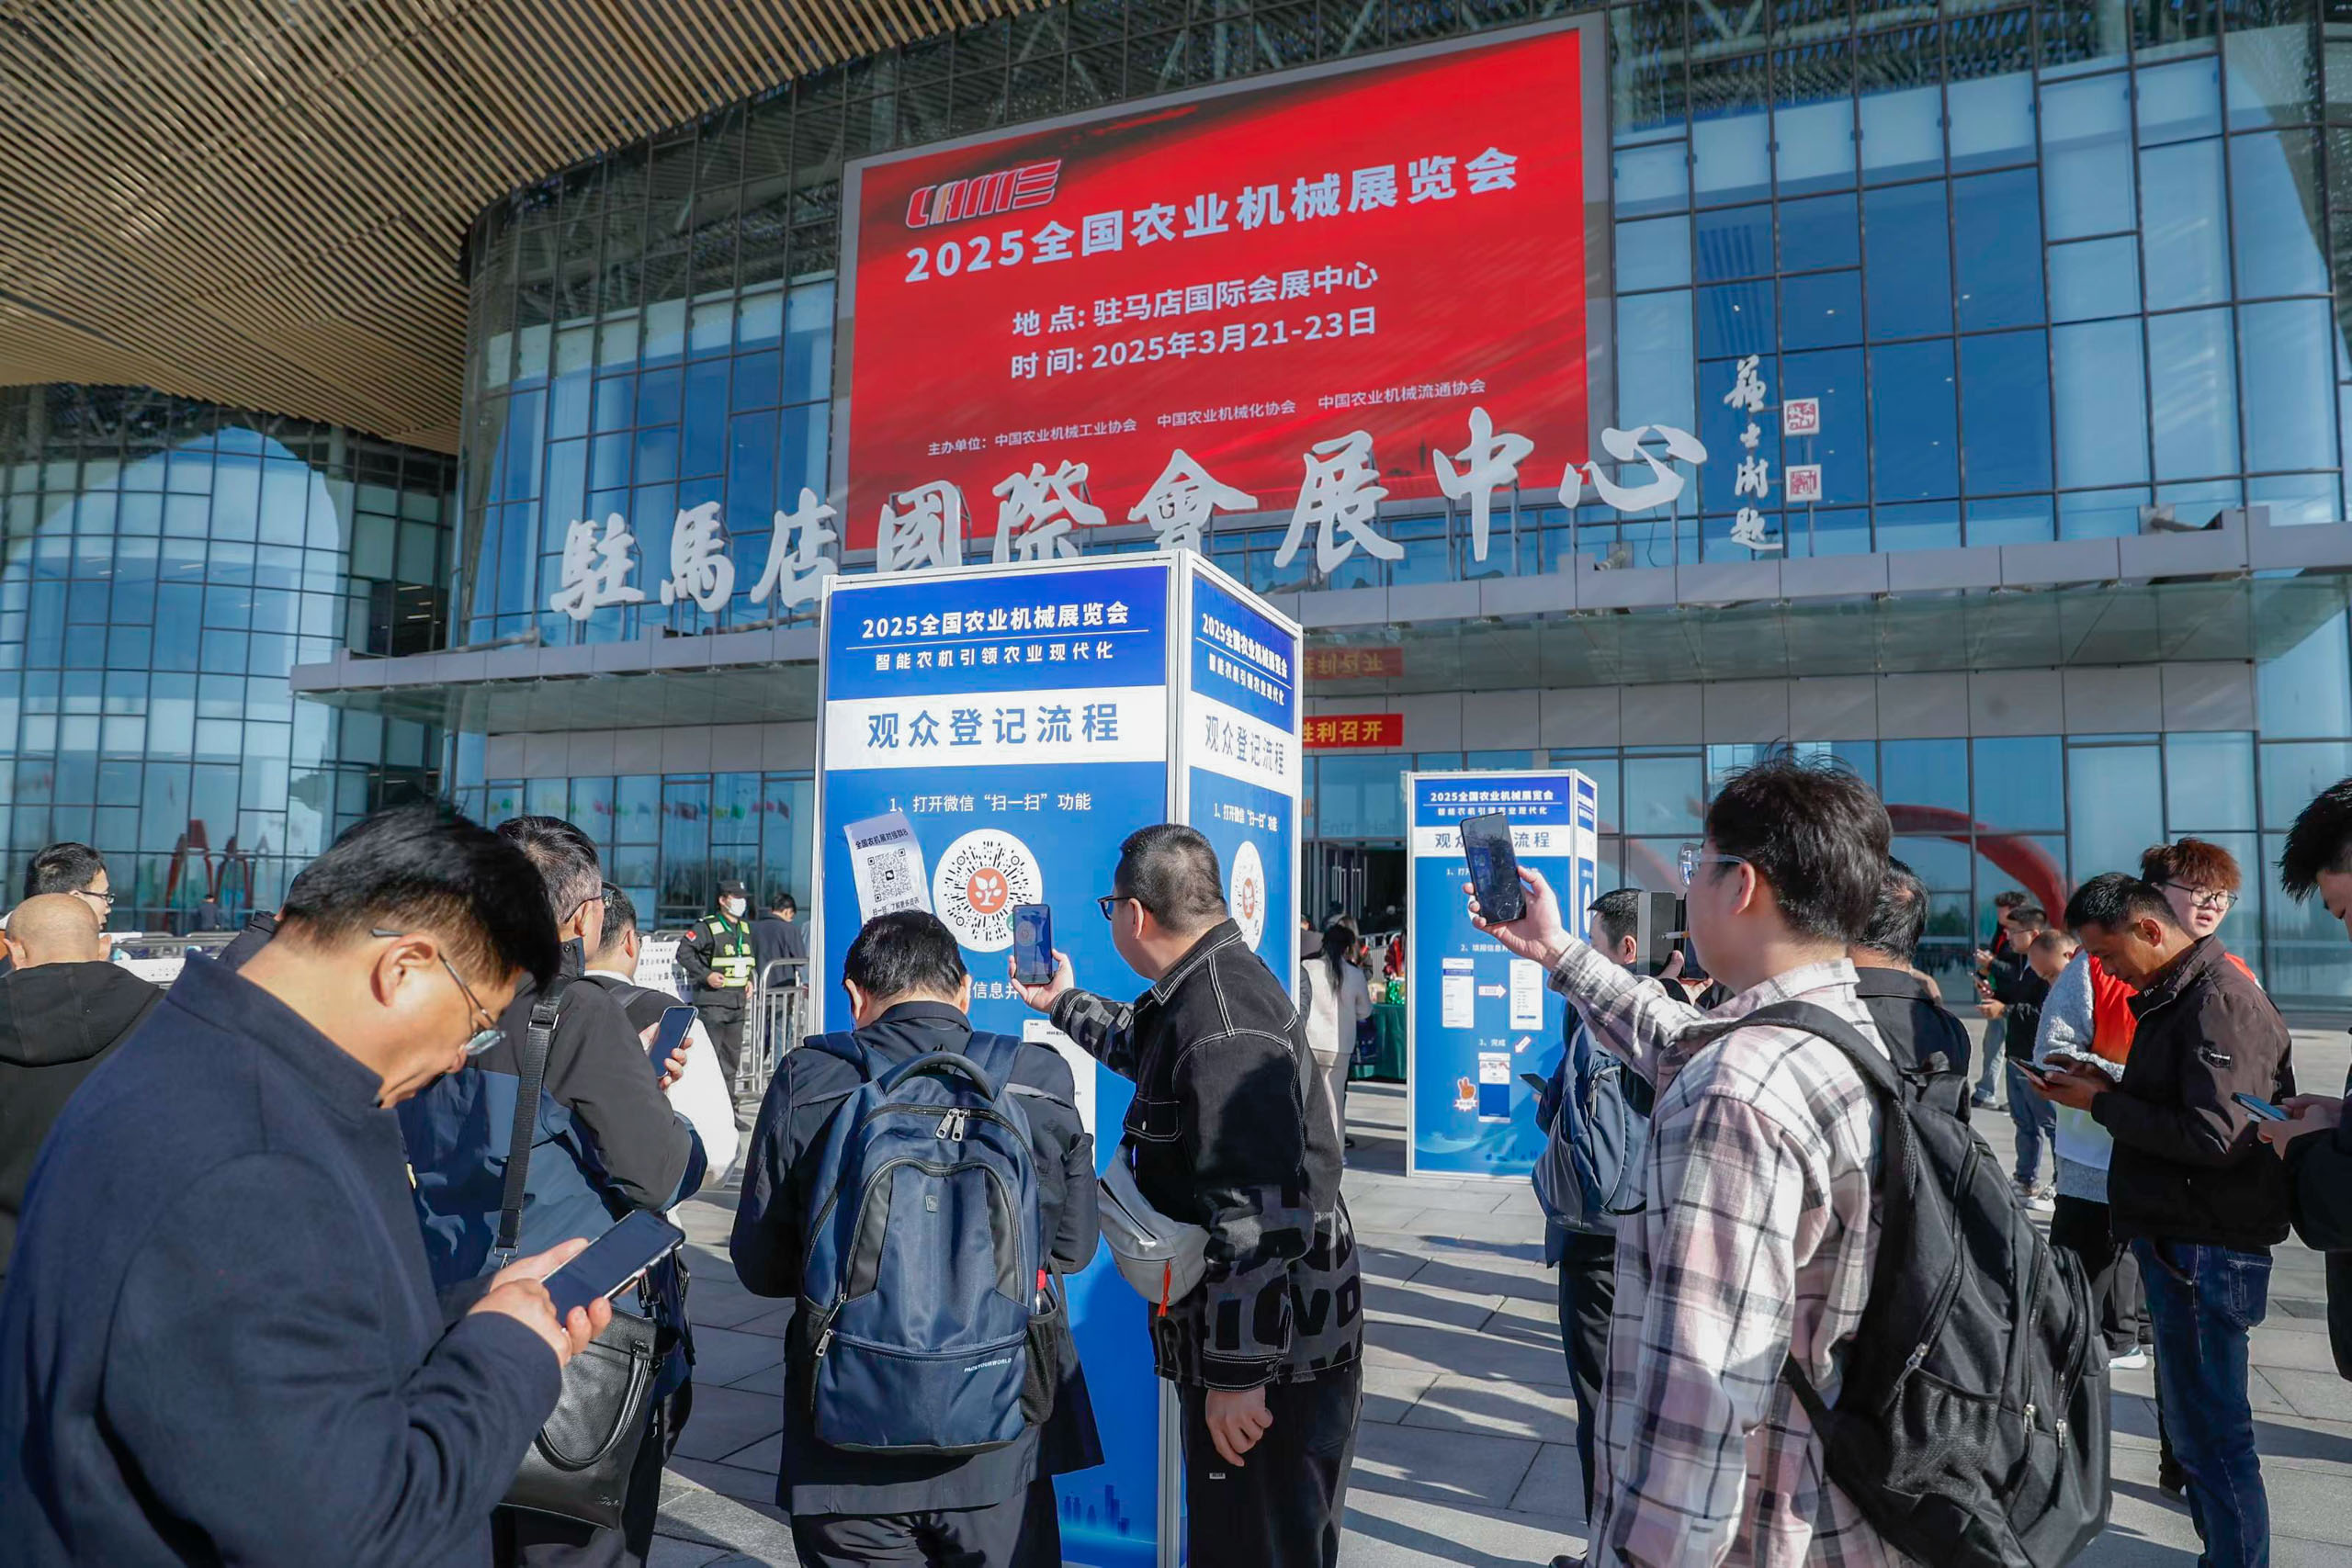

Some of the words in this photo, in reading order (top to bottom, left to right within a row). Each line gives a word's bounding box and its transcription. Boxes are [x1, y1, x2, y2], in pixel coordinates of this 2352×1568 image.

[904, 147, 1519, 284] 2025全国农业机械展览会
[1157, 400, 1296, 427] 中国农业机械化协会
[1318, 379, 1486, 410] 中国农业机械流通协会
[862, 602, 1129, 638] 2025全国农业机械展览会
[876, 642, 1113, 671] 智能农机引领农业现代化
[1202, 614, 1287, 679] 2025全国农业机械展览会
[867, 704, 1119, 749] 观众登记流程
[1205, 715, 1284, 775] 观众登记流程
[1430, 790, 1554, 802] 2025全国农业机械展览会
[969, 982, 1019, 999] 信息并
